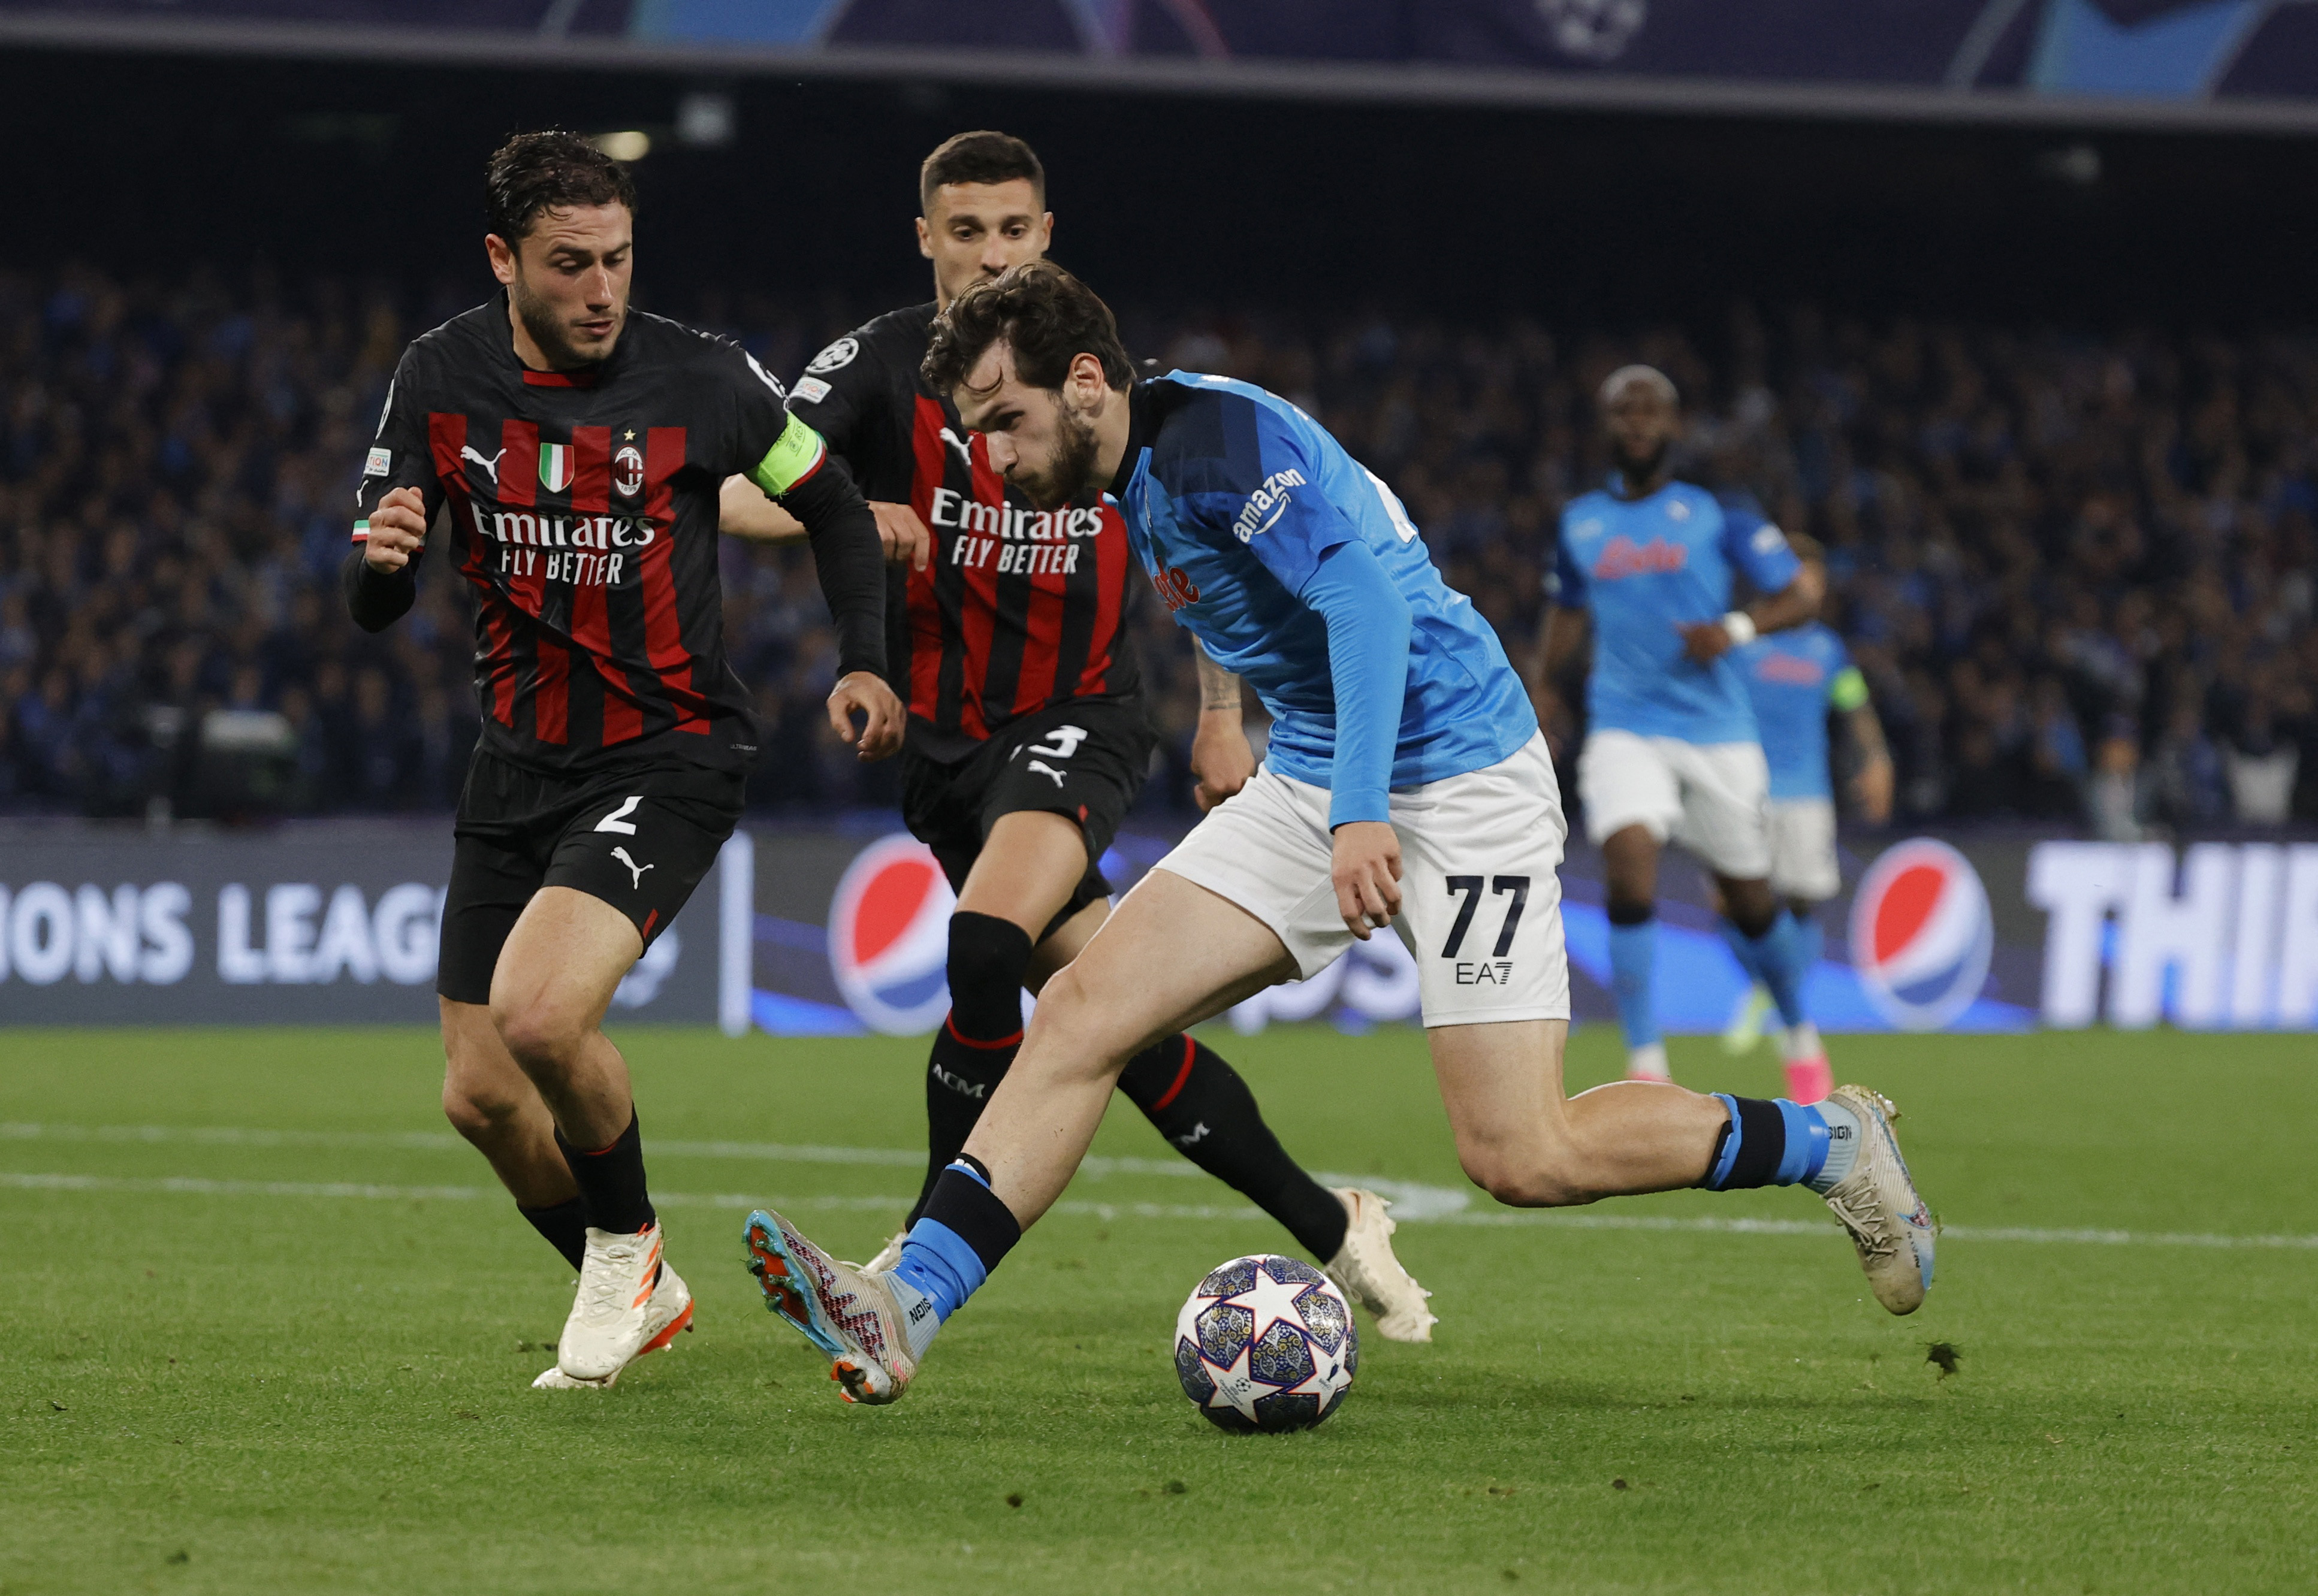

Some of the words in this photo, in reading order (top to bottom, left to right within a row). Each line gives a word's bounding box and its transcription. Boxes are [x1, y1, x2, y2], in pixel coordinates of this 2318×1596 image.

[470, 501, 656, 549] Emirates
[931, 486, 1103, 540] Emirates
[1233, 468, 1306, 543] amazon
[501, 544, 536, 576] FLY
[546, 549, 624, 587] BETTER
[951, 535, 995, 569] FLY
[997, 543, 1079, 575] BETTER
[1154, 555, 1200, 612] ete
[217, 882, 448, 985] LEAG
[1441, 875, 1531, 959] 77
[1456, 962, 1514, 984] EA7
